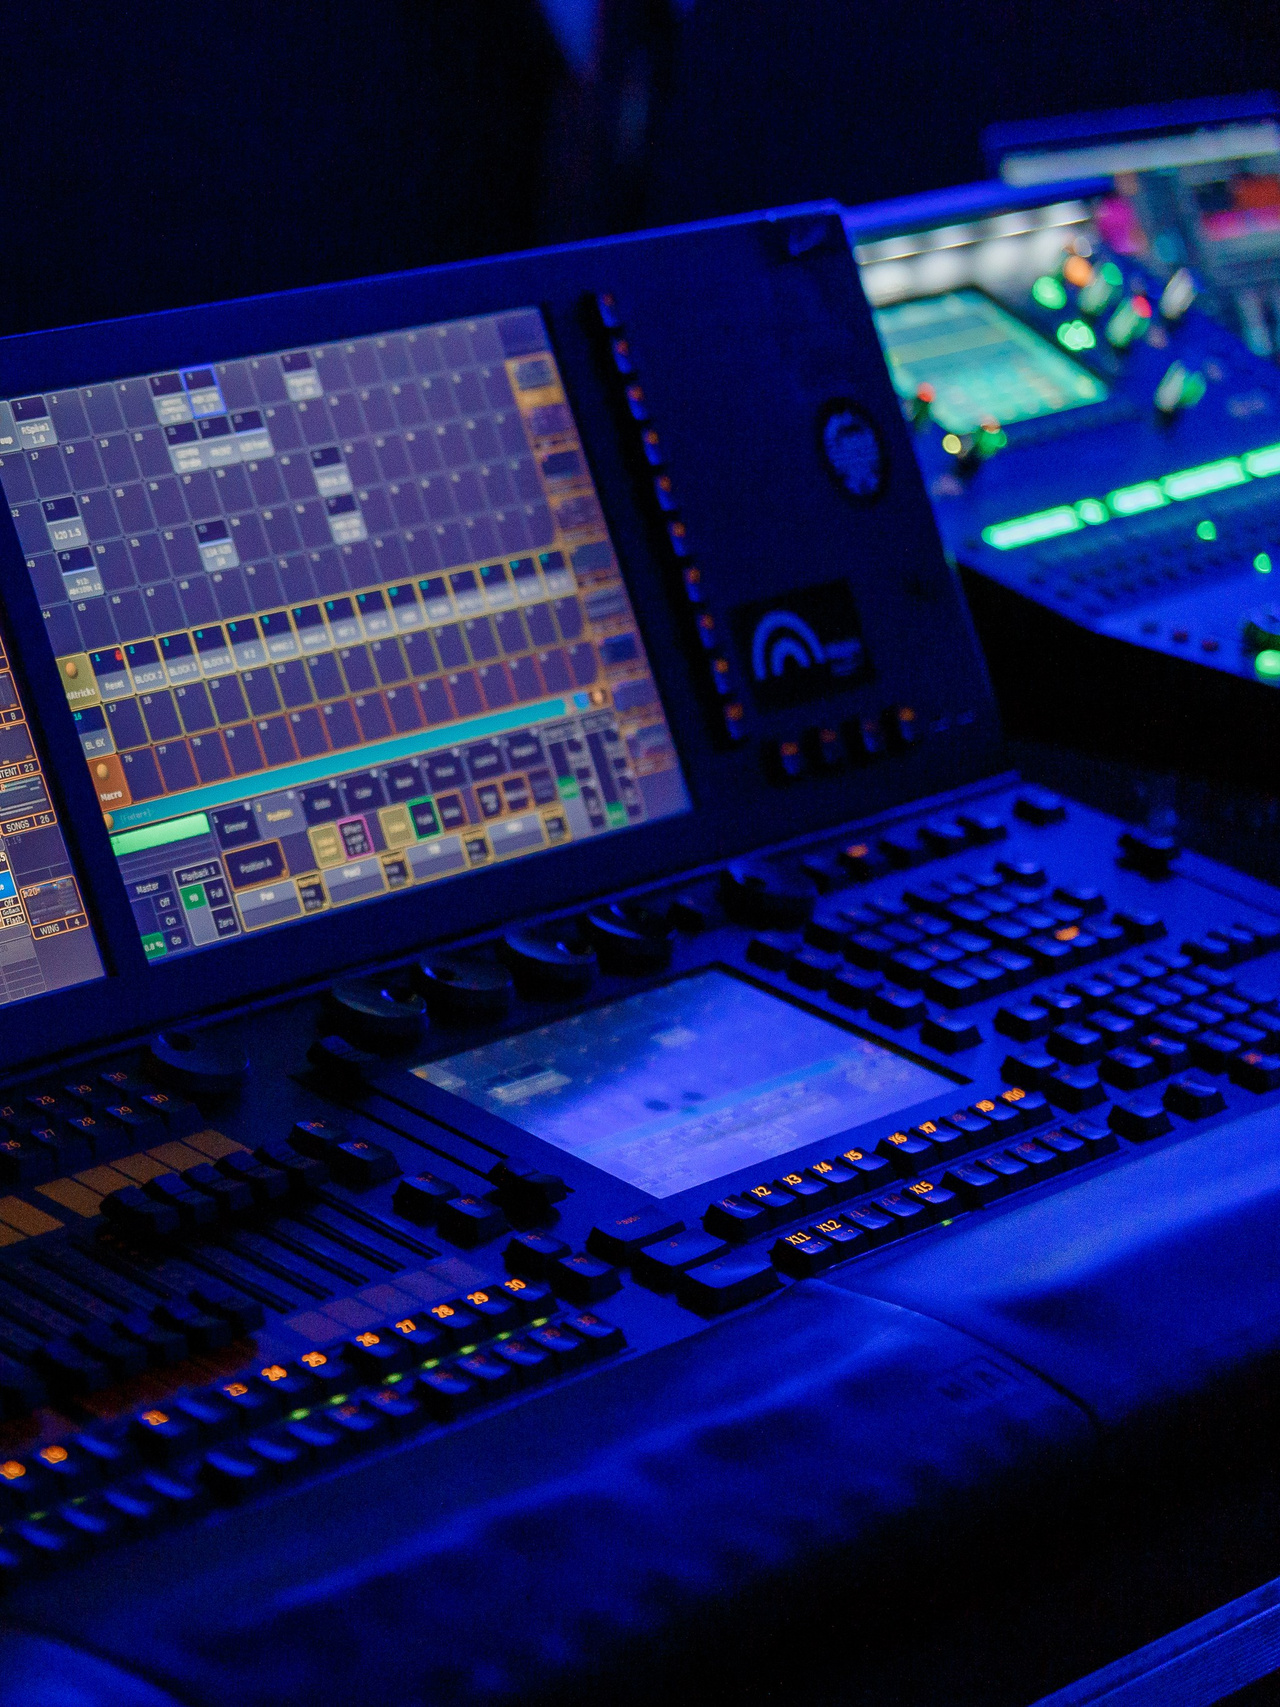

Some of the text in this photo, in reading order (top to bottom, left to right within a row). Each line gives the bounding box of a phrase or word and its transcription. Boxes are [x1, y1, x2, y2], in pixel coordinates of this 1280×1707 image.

[24, 764, 35, 773] 23
[101, 790, 123, 802] Macro
[40, 815, 50, 824] 26
[6, 820, 30, 833] SONGS
[136, 882, 159, 895] Master
[210, 888, 224, 899] Full
[160, 897, 170, 908] Off
[6, 916, 23, 926] Flash
[166, 916, 176, 926] On
[218, 917, 235, 929] Zero
[40, 923, 60, 936] WING
[171, 936, 182, 945] Go
[109, 1072, 128, 1082] 30
[150, 1093, 169, 1104] 30
[114, 1106, 133, 1116] 29
[77, 1117, 97, 1127] 28
[919, 1121, 938, 1135] X7
[888, 1132, 908, 1145] X6
[1, 1140, 21, 1151] 26
[843, 1149, 863, 1162] X5
[813, 1161, 833, 1174] X4
[783, 1173, 803, 1186] X3
[751, 1185, 772, 1198] X2
[909, 1181, 934, 1195] X15
[816, 1219, 842, 1233] X12
[785, 1232, 812, 1246] X11
[504, 1278, 527, 1292] 30
[467, 1291, 489, 1305] 29
